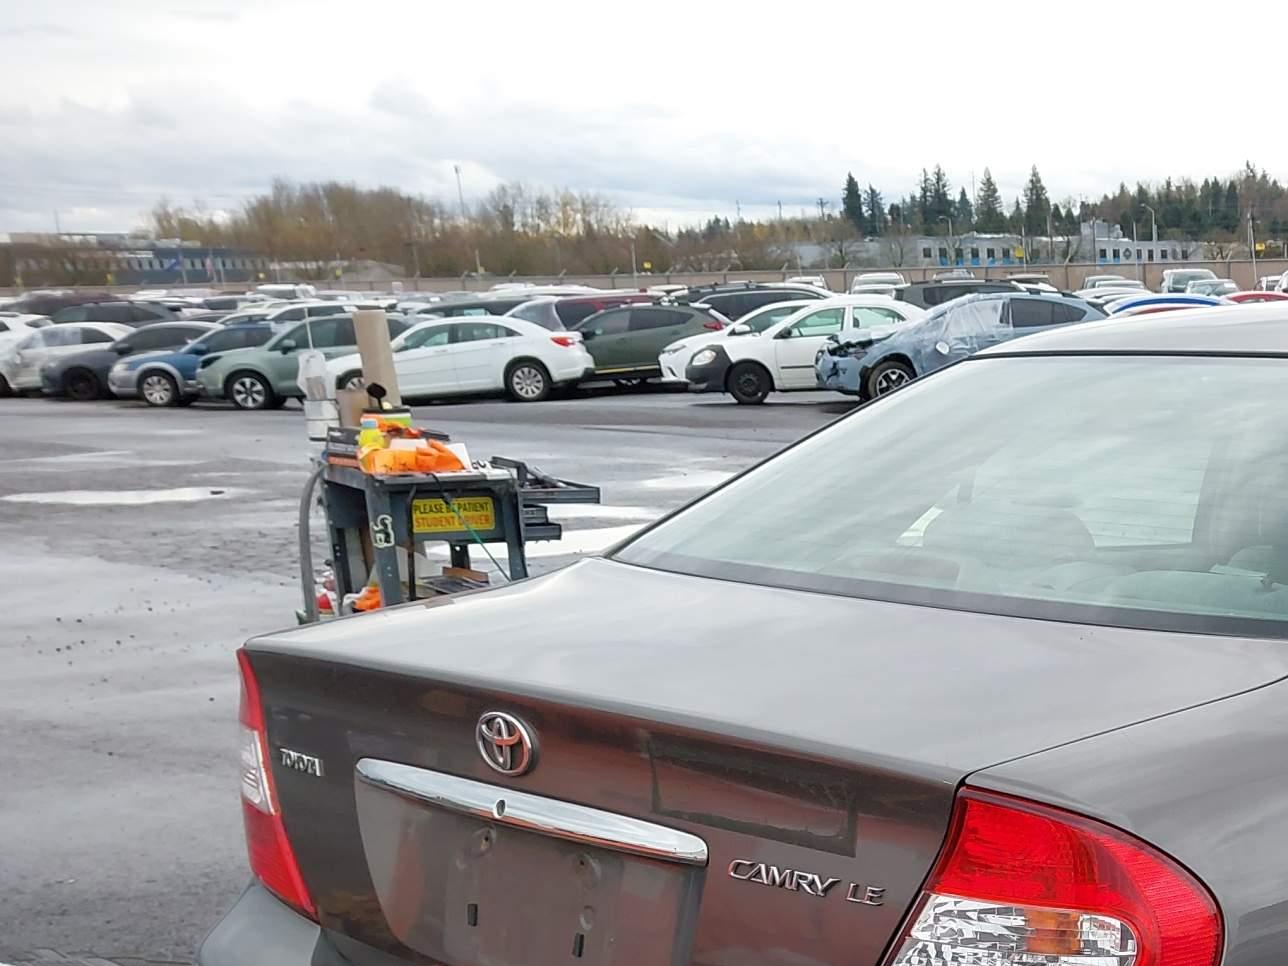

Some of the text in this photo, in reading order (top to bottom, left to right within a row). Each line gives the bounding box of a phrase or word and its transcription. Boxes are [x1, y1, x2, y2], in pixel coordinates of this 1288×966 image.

[414, 503, 445, 515] PLEASE
[458, 501, 489, 513] PATIENT
[415, 516, 455, 529] STUDENT
[728, 859, 886, 906] CAMRY LE
